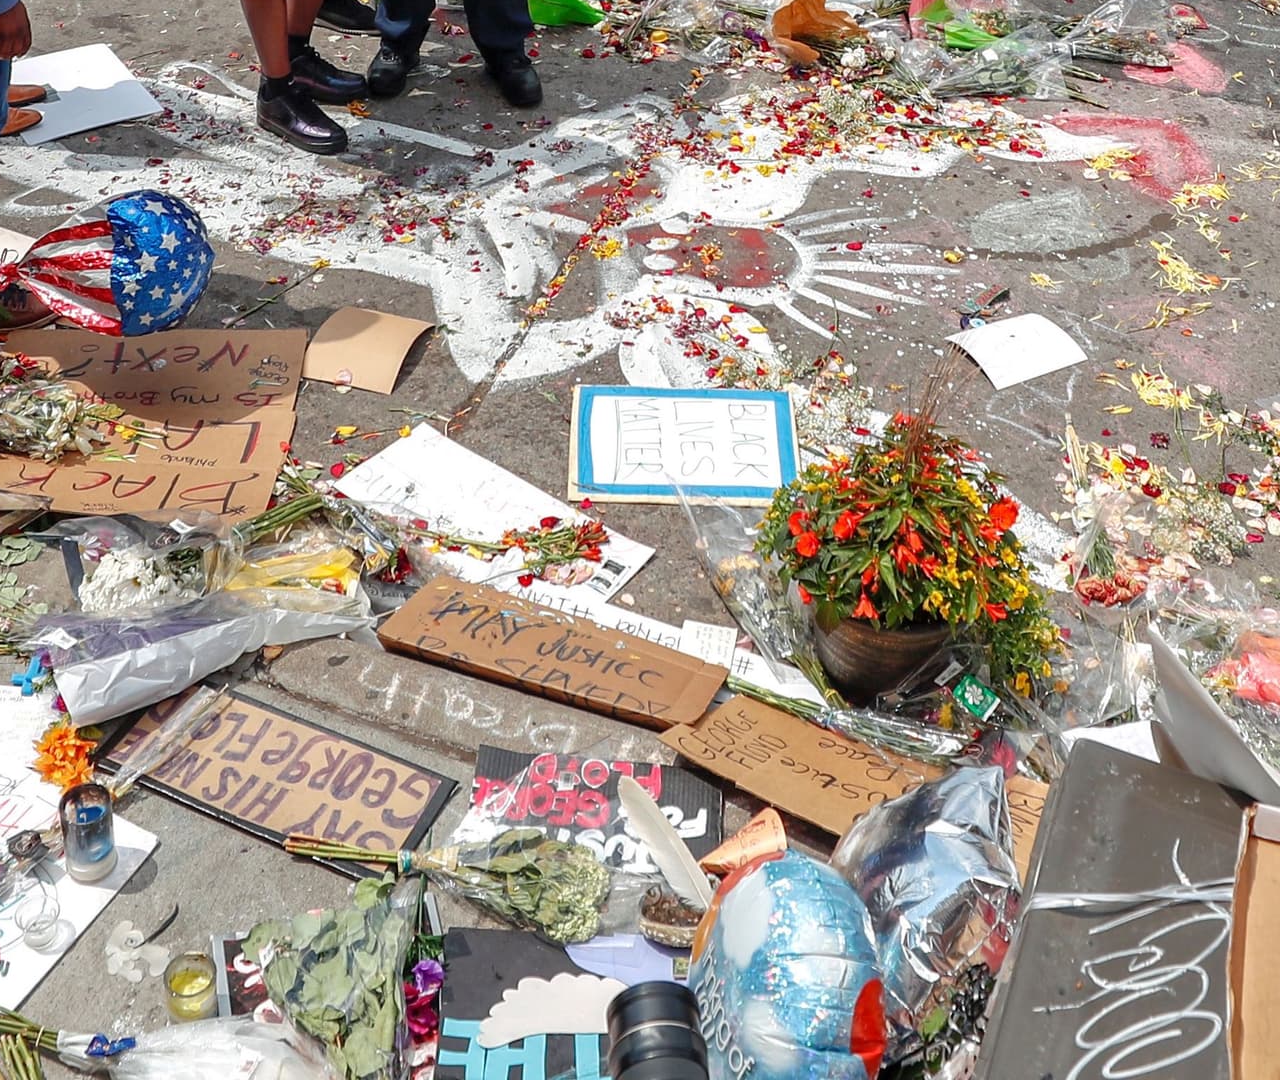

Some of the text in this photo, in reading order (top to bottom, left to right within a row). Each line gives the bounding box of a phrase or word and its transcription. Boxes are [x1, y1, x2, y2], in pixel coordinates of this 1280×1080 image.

[76, 388, 161, 407] Broth
[170, 386, 219, 410] my
[623, 398, 665, 478] MATTER
[673, 399, 716, 476] LIVES
[727, 403, 769, 479] BLACK
[678, 709, 759, 761] GEORGE
[201, 766, 290, 825] HIS
[775, 753, 890, 804] ustice
